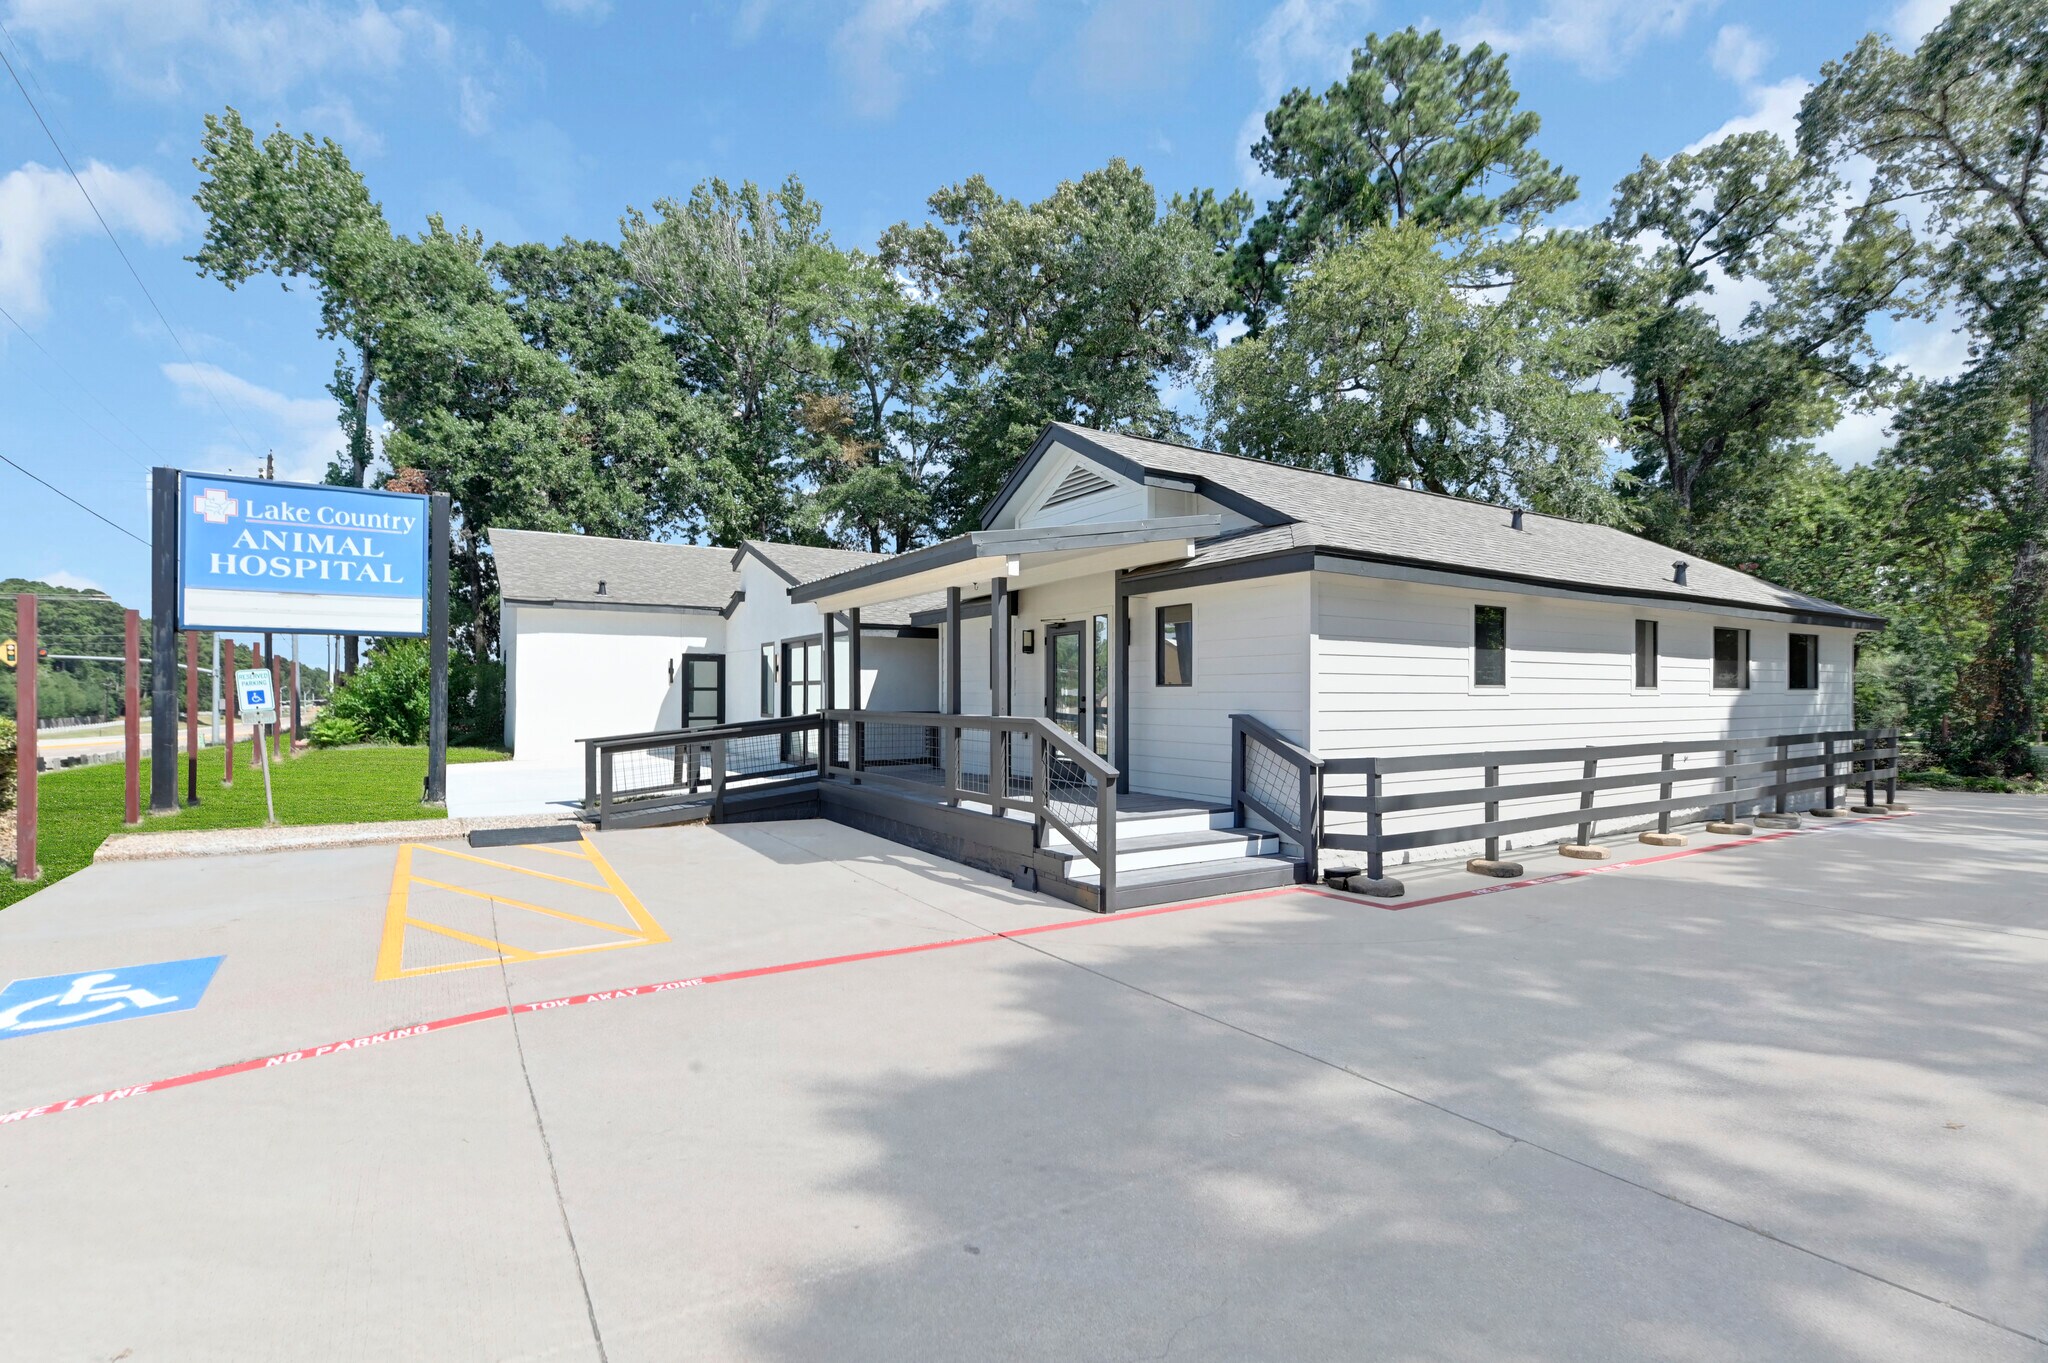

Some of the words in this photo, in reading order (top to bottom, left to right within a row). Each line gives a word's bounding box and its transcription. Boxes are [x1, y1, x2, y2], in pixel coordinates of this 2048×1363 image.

[246, 500, 311, 522] Lake
[317, 506, 417, 535] Country
[232, 529, 385, 558] ANIMAL
[209, 553, 404, 584] HOSPITAL
[526, 999, 570, 1011] TOW
[586, 988, 639, 1003] AWAY
[652, 977, 706, 992] ZONE
[265, 1052, 303, 1067] NO
[315, 1025, 429, 1057] PARKING
[62, 1083, 153, 1111] LANE
